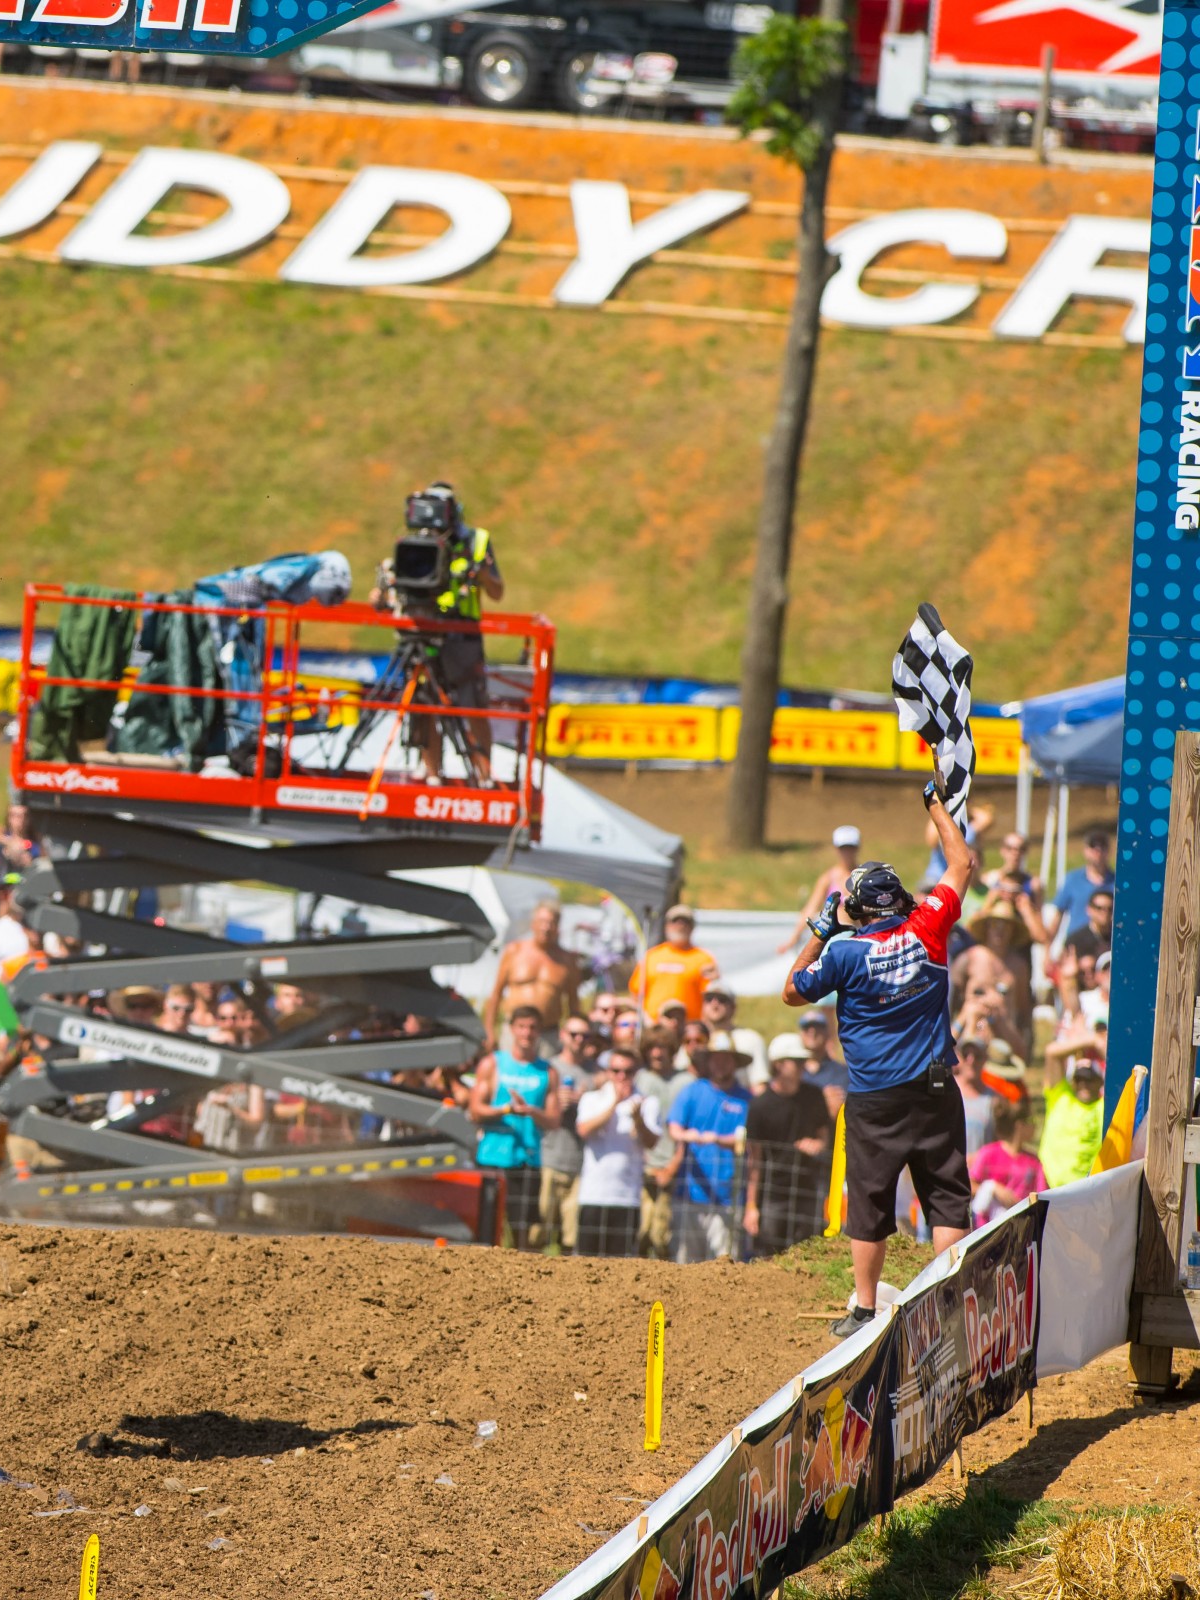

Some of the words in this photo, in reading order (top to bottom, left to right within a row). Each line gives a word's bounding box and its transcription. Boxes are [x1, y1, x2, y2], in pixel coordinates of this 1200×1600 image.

[24, 768, 120, 793] SKYJACK
[414, 794, 484, 822] SJ7135
[487, 801, 516, 825] RT
[870, 947, 925, 971] MOTOCROSS
[90, 1028, 147, 1052] United
[150, 1041, 212, 1069] Rentals
[280, 1076, 375, 1111] SKYJACK
[963, 1264, 1004, 1398] Red
[691, 1471, 748, 1600] Red
[740, 1433, 792, 1585] Bull
[88, 1555, 96, 1596] ACERBIS
